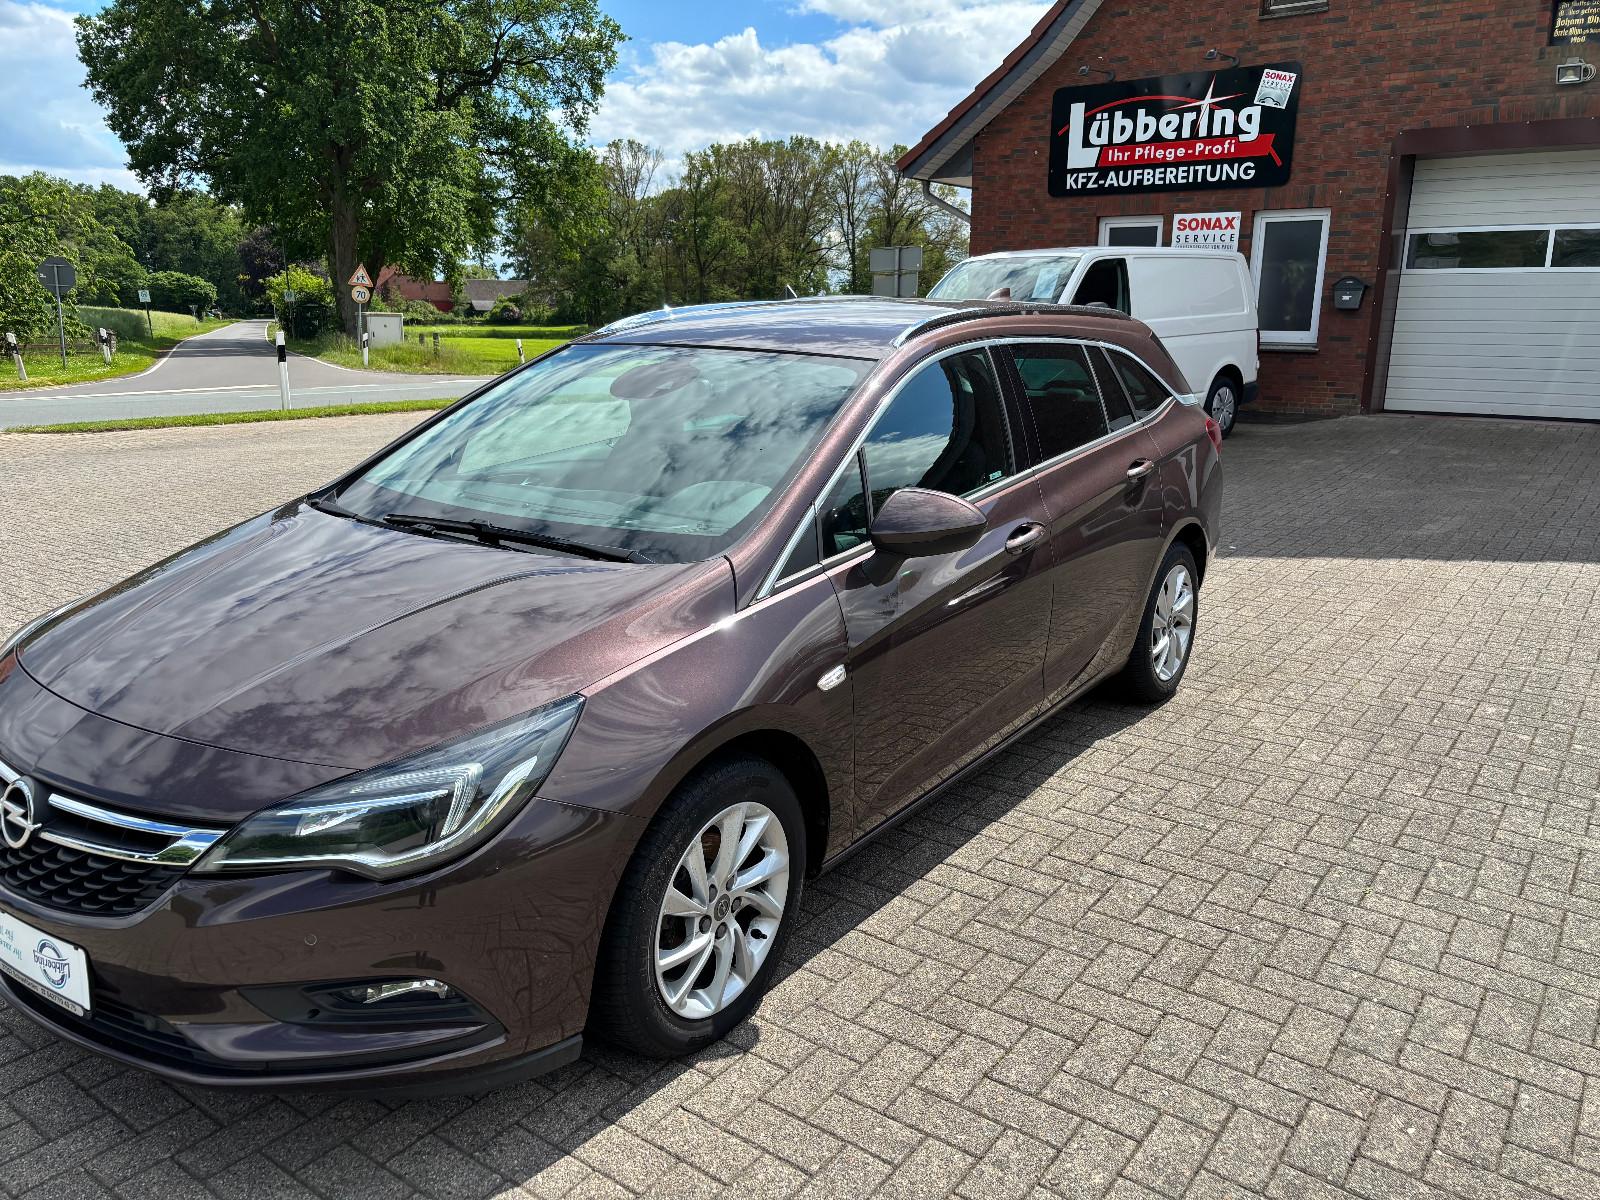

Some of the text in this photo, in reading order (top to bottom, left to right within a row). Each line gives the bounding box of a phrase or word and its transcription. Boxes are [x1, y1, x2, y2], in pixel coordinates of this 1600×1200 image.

[1265, 72, 1294, 82] SONAX
[1067, 102, 1261, 169] Lübbering
[1108, 140, 1235, 161] Ihr Pflege-Profi
[1066, 162, 1256, 189] KFZ-AUFBEREITUNG
[1177, 217, 1236, 231] SONAX
[1176, 234, 1235, 243] SERVICE
[356, 290, 366, 299] 70
